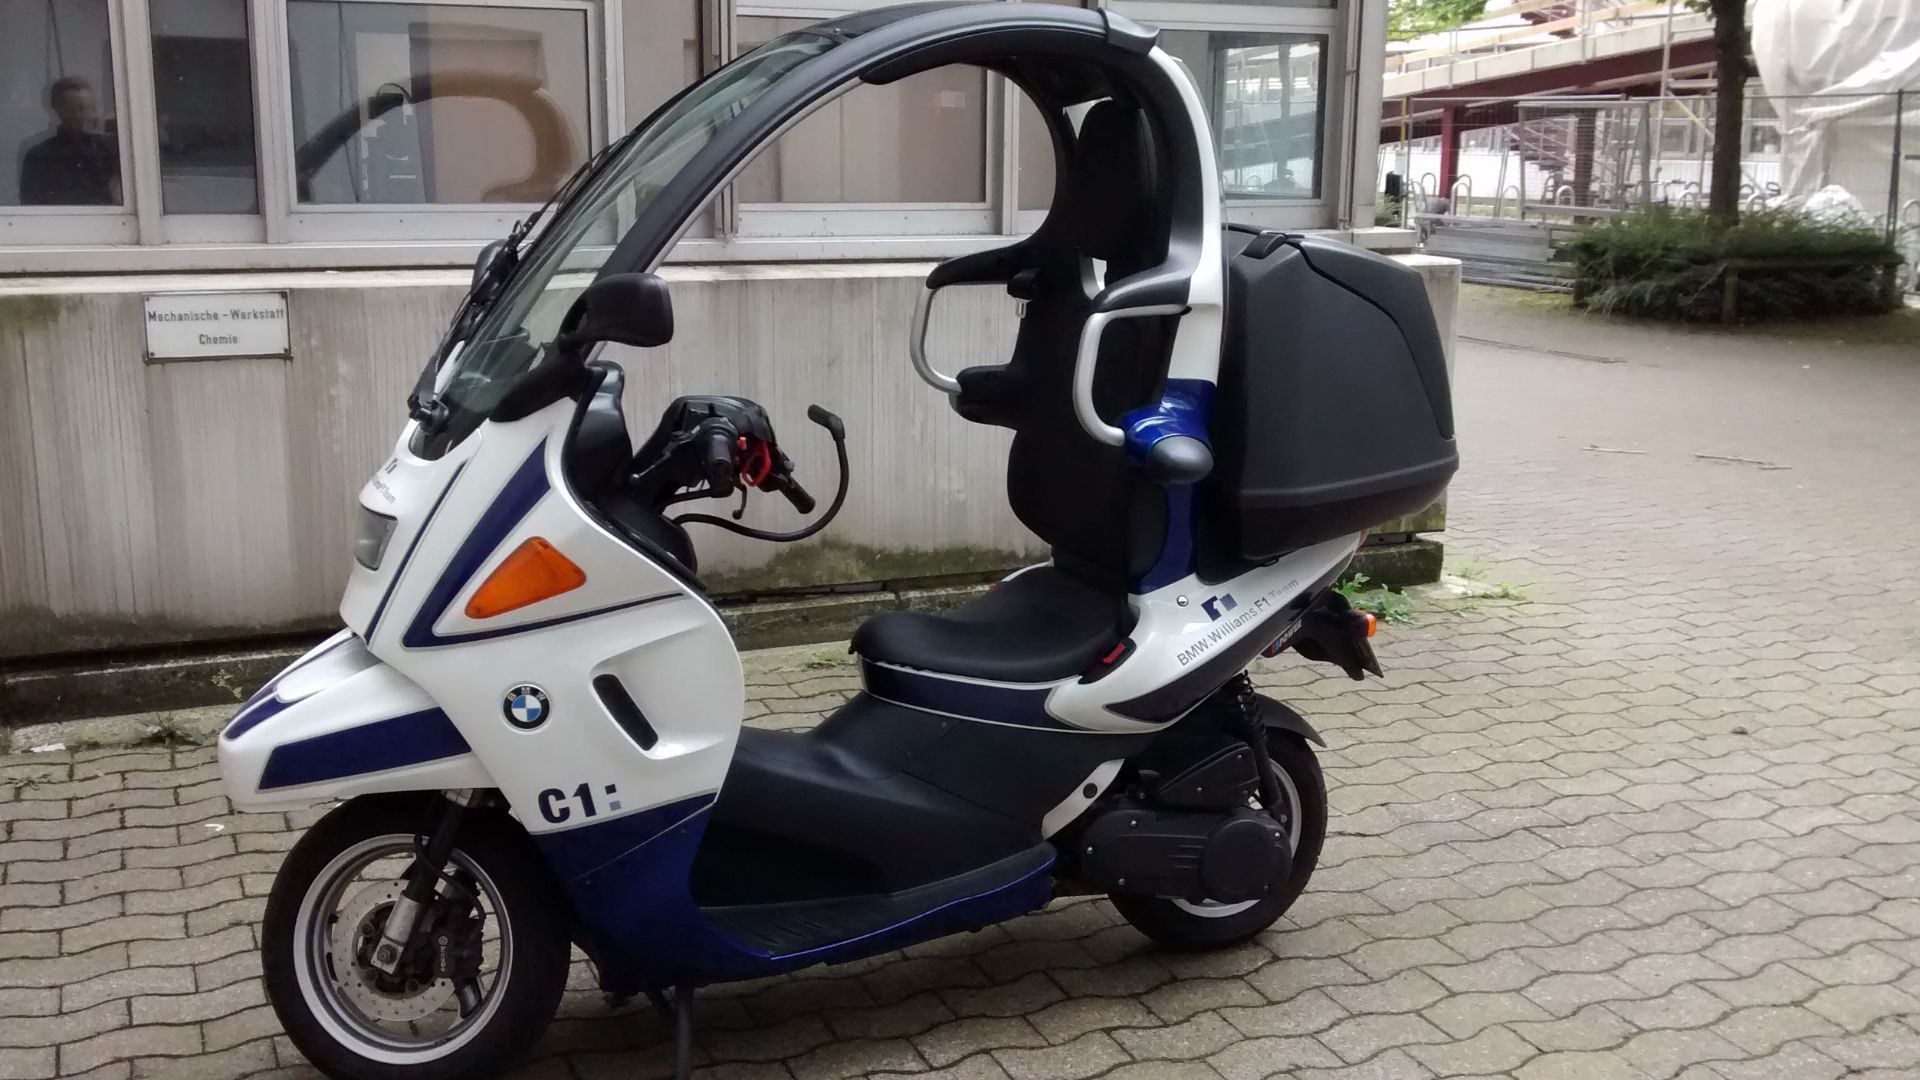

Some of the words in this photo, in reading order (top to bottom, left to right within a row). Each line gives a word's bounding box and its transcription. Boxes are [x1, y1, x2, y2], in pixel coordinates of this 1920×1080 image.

[148, 310, 220, 323] Mechanische
[230, 308, 285, 320] Werkstatt
[198, 333, 239, 345] Chemie
[1254, 596, 1272, 613] F1
[1267, 579, 1300, 600] Team
[506, 686, 547, 702] BMW
